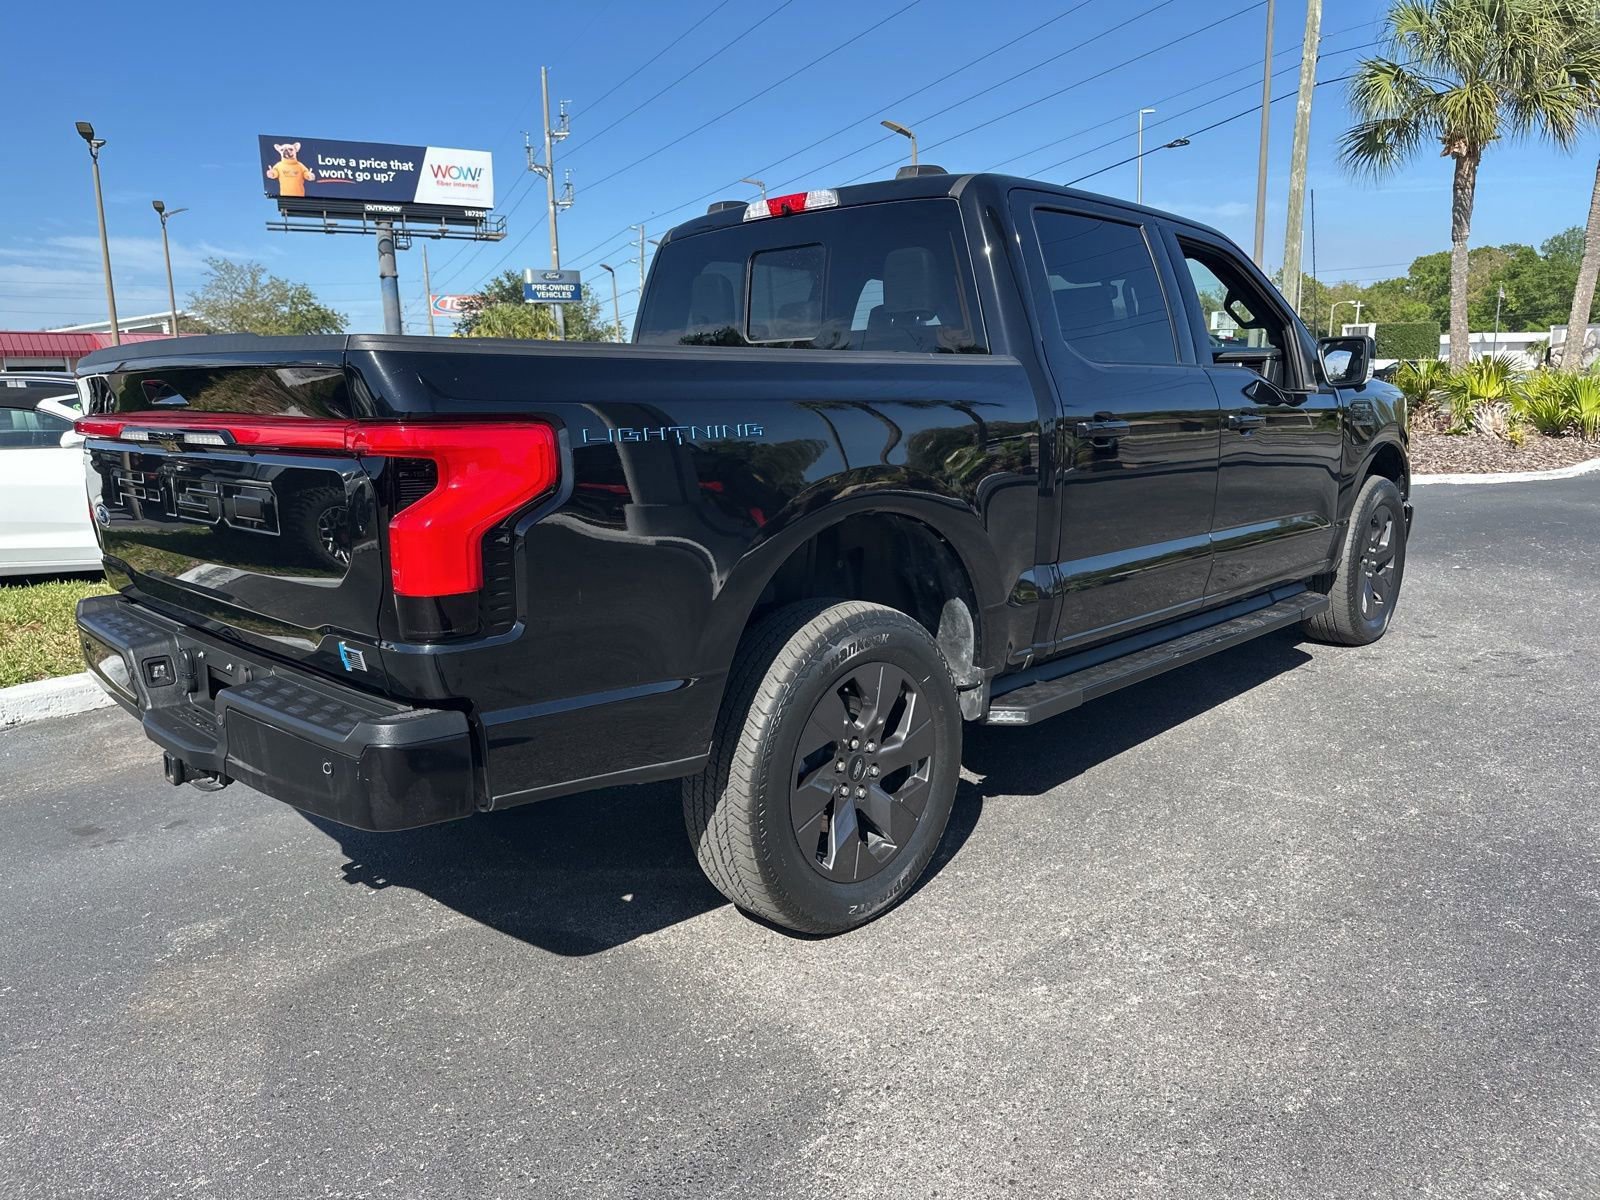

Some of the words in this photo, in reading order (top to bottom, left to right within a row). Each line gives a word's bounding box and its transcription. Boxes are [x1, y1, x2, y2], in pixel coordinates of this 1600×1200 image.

[318, 154, 346, 166] Love
[349, 158, 356, 167] a
[359, 157, 388, 170] price
[389, 159, 414, 172] that
[318, 168, 353, 179] won't
[355, 171, 370, 182] go
[373, 171, 396, 184] up?
[430, 163, 482, 182] WOW!
[531, 284, 576, 292] PRE-OWNED
[536, 291, 572, 299] VEHICLES
[582, 423, 765, 446] LIGHTNING
[110, 467, 281, 537] F-150
